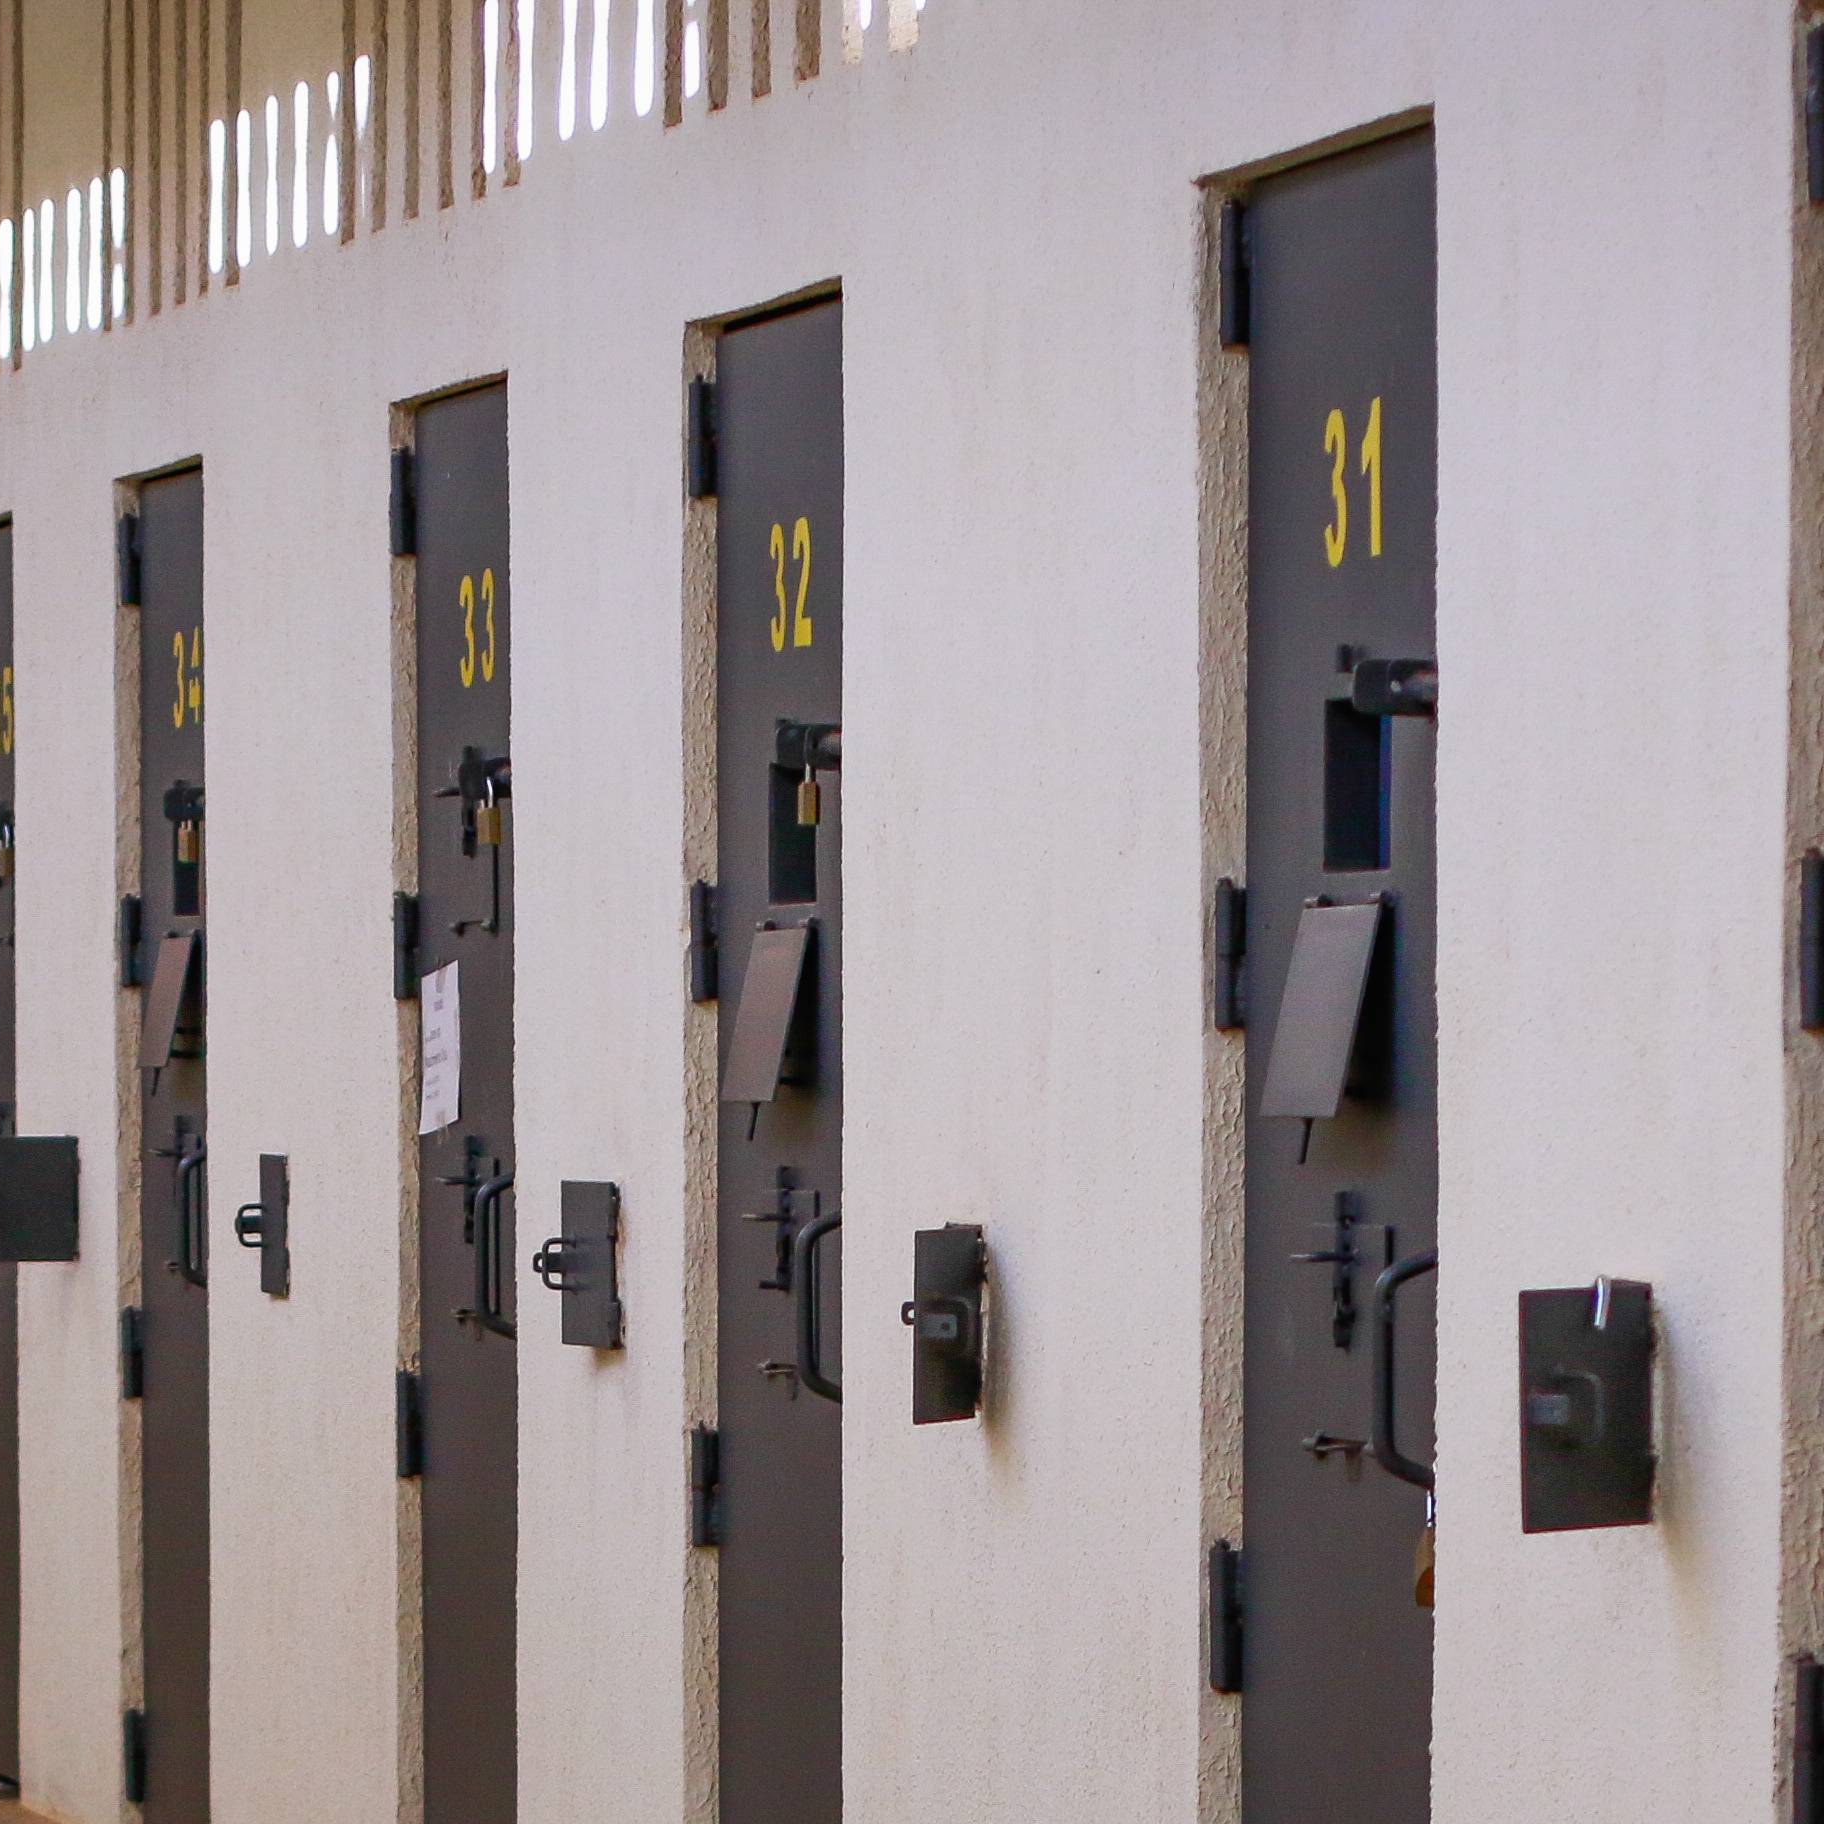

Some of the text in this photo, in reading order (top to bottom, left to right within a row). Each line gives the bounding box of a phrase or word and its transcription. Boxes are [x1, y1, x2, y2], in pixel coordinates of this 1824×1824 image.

[1323, 397, 1383, 568] 31
[459, 568, 497, 688] 33
[770, 516, 813, 653] 32
[172, 625, 202, 729] 34
